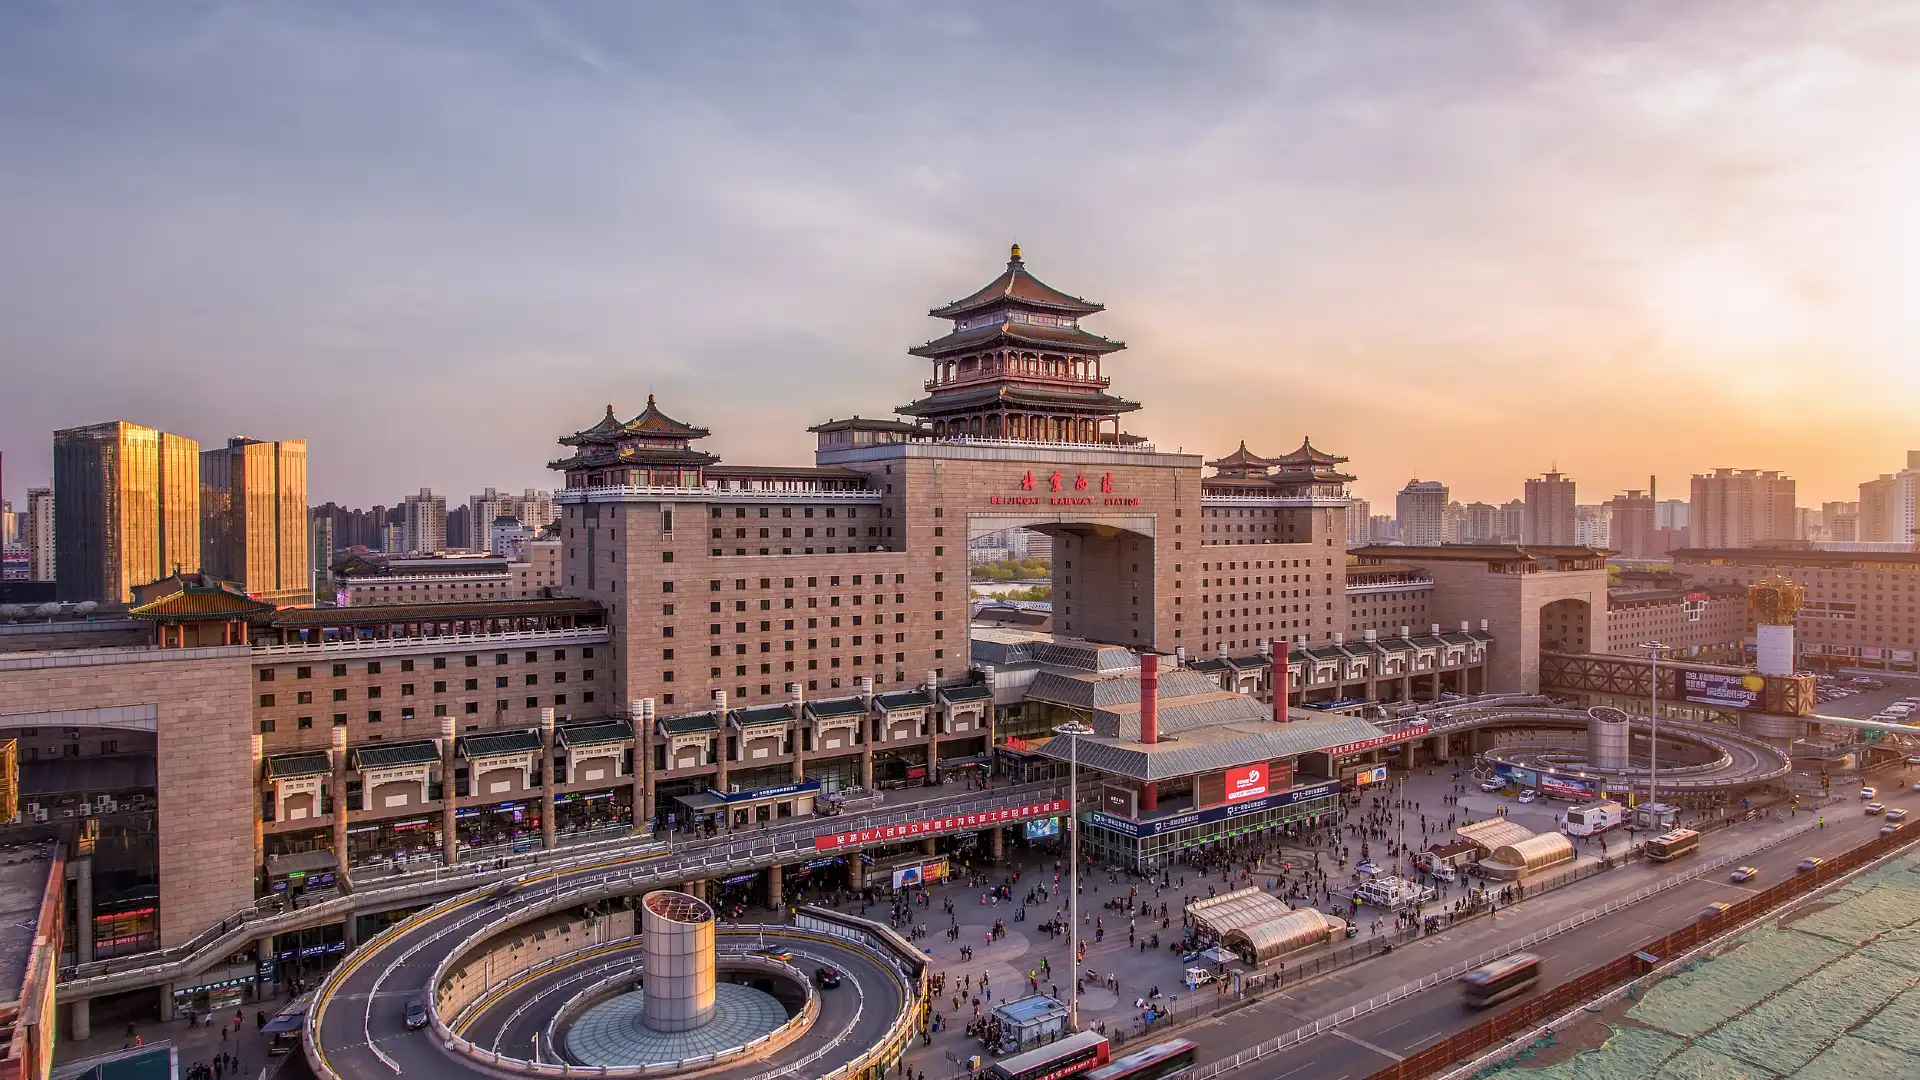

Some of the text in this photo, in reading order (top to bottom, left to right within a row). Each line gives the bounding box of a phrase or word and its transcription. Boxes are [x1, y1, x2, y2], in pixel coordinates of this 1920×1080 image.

[1021, 471, 1113, 493] 北京西站
[990, 496, 1141, 506] BEIJINGXI RAILWAY STATION
